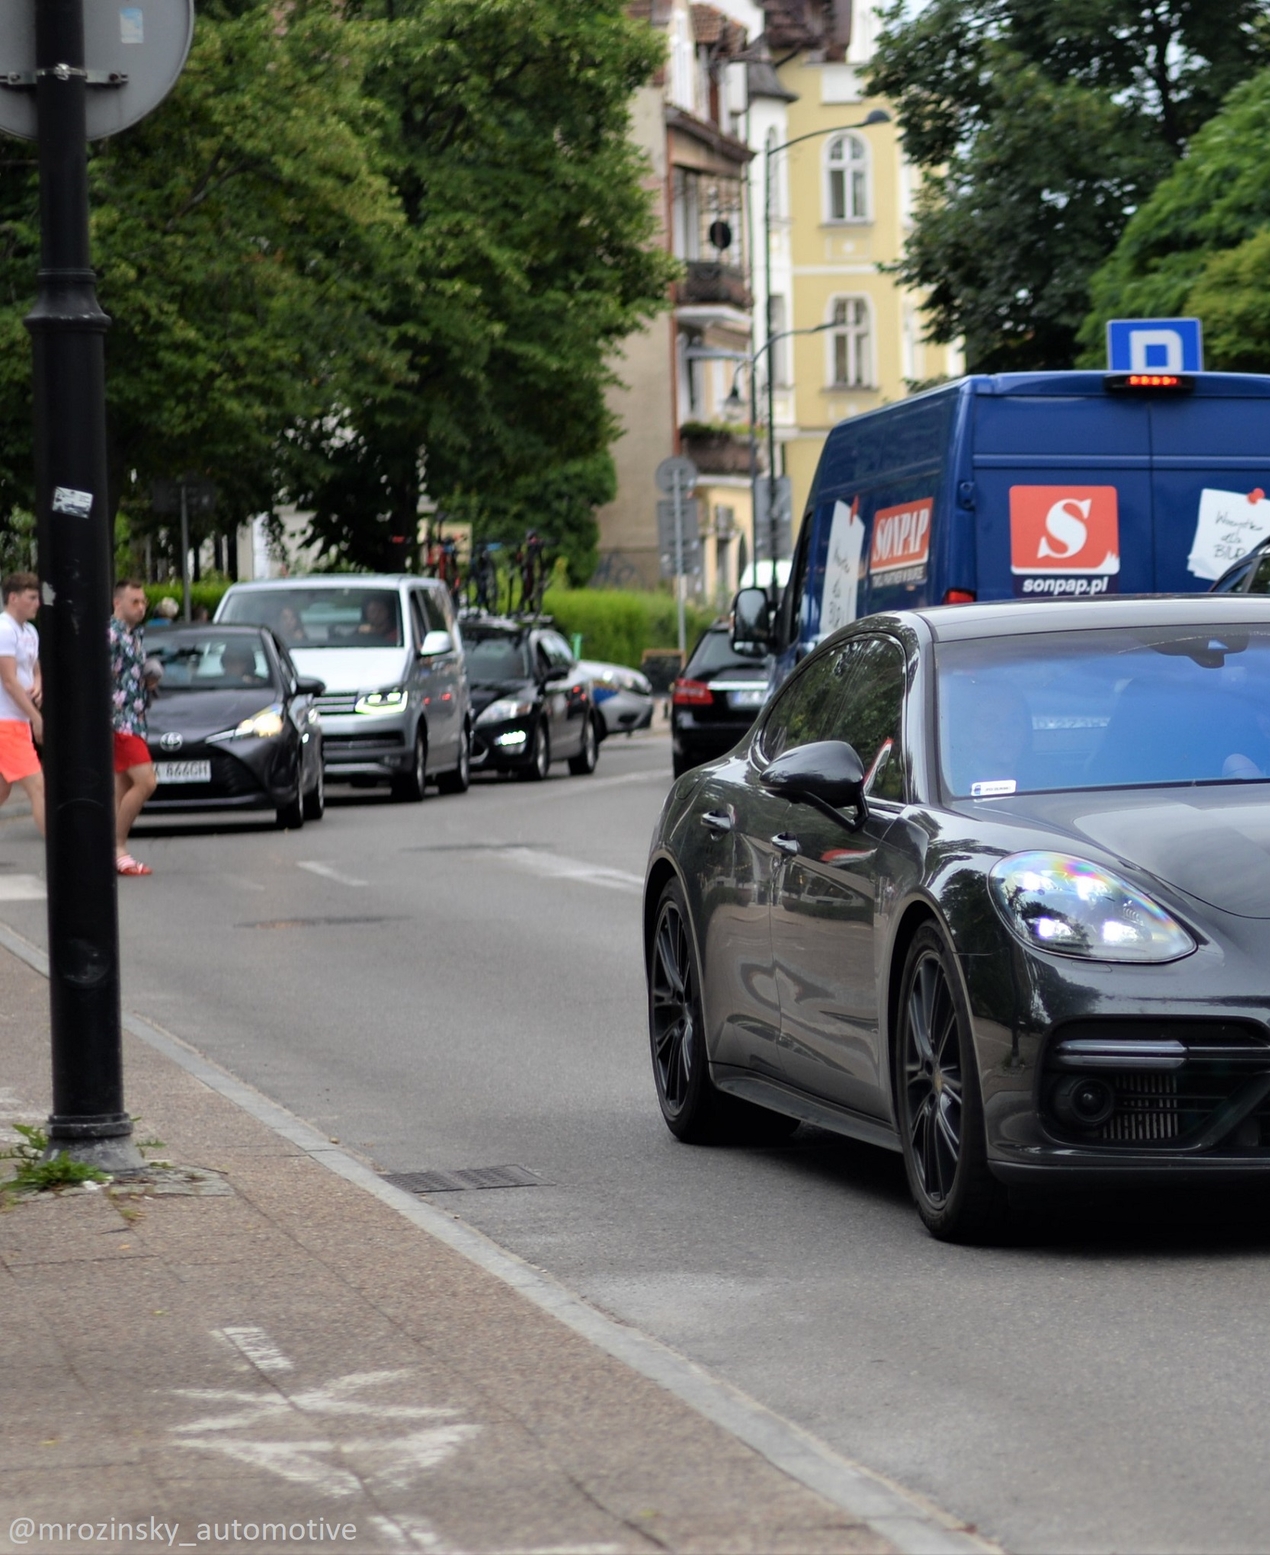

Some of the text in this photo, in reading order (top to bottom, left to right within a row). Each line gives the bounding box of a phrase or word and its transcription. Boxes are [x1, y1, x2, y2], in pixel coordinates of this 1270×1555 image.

[1130, 330, 1183, 372] P
[872, 508, 931, 562] SONPAP
[1037, 498, 1092, 559] S
[1022, 576, 1109, 596] sonpap.pl
